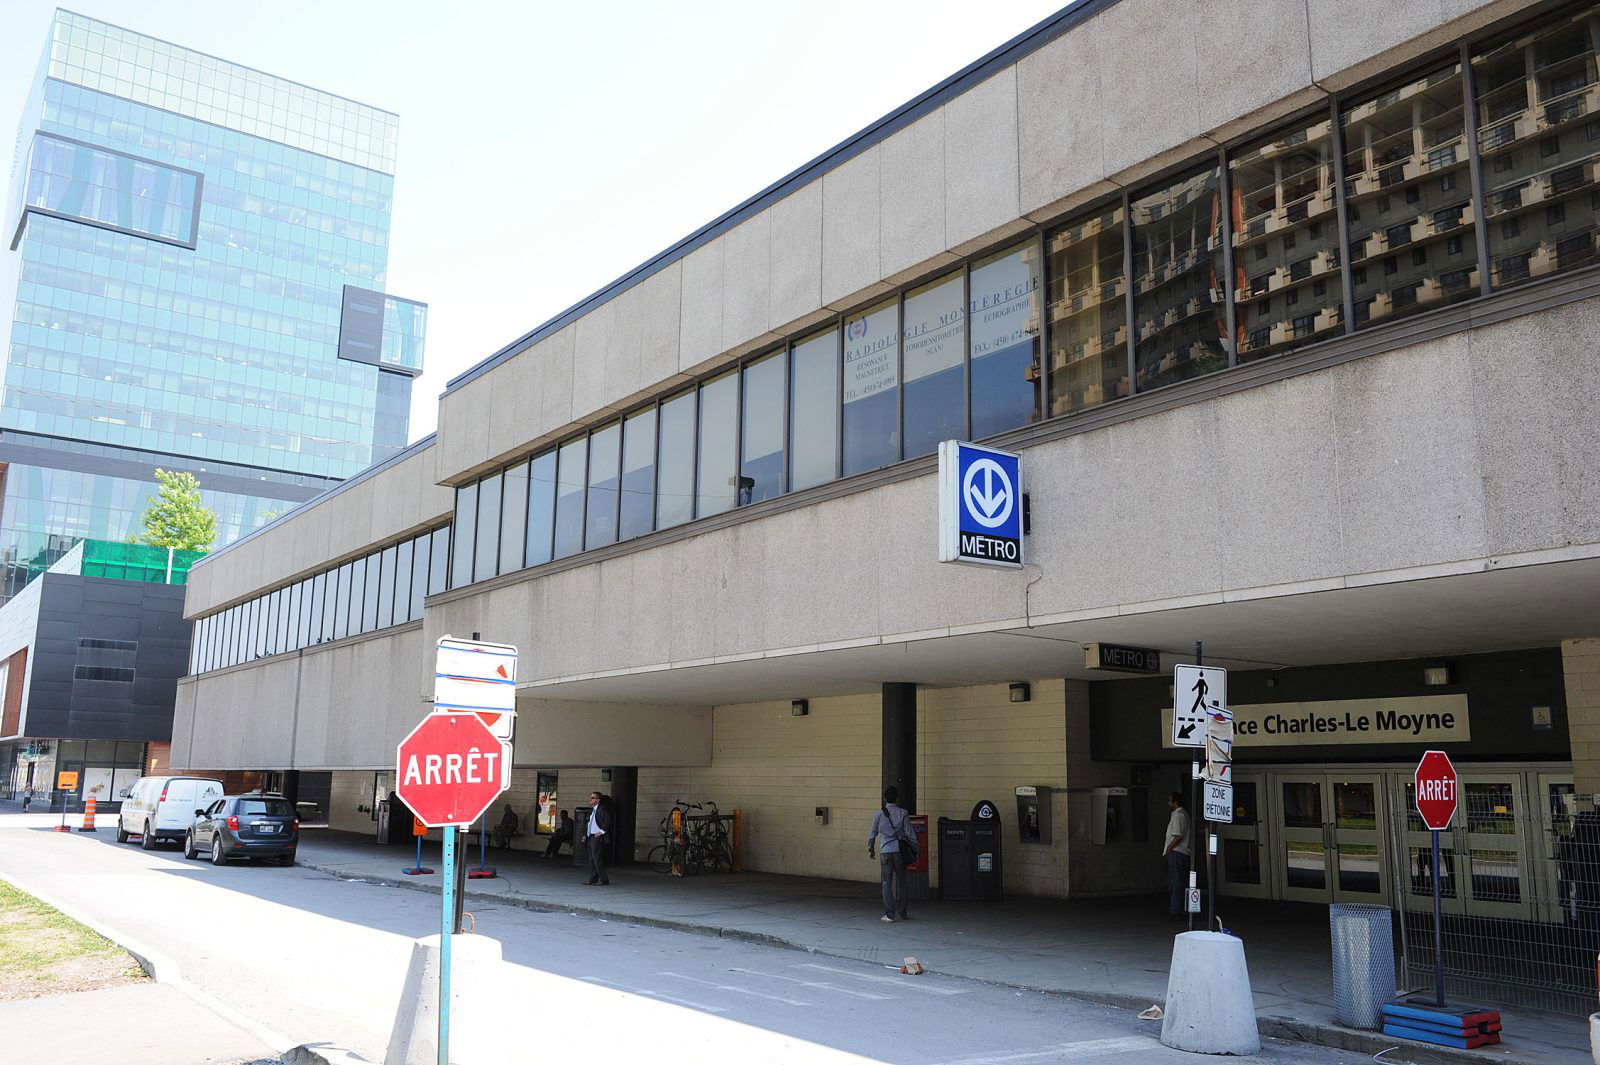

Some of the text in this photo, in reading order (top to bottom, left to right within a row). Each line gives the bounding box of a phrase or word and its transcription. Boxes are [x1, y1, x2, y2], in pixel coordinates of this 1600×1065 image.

[1263, 712, 1370, 735] Charles-Le
[1375, 709, 1455, 739] Moyne
[403, 747, 499, 787] ARRÊT
[1211, 787, 1226, 800] ZONE
[1418, 776, 1455, 801] ARRÊT
